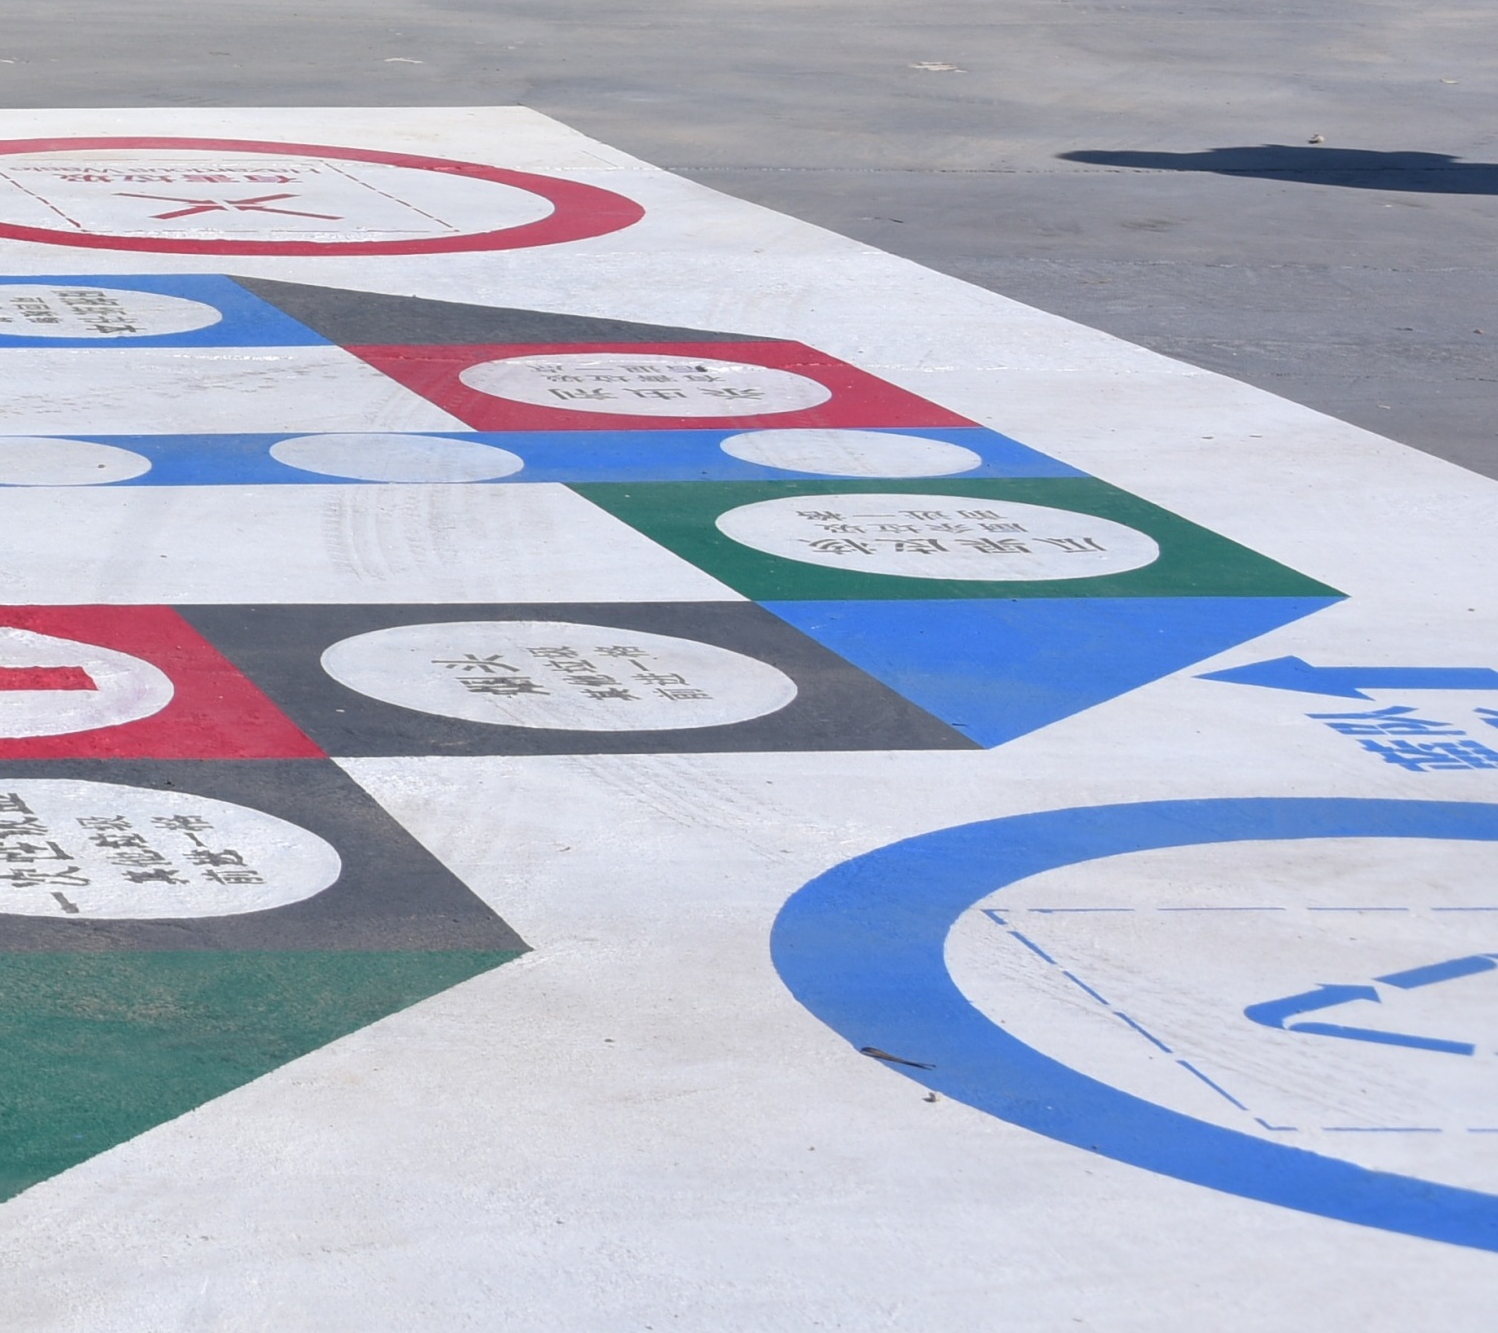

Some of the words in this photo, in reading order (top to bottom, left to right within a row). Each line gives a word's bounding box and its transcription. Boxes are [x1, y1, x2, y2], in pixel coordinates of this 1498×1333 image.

[51, 173, 304, 184] 有害垃圾
[548, 388, 765, 401] 杀虫剂
[795, 510, 1008, 521] 前进一格
[813, 523, 1026, 533] 厨余垃圾
[796, 538, 1107, 556] 瓜果皮核
[430, 651, 550, 696] 烟头
[526, 642, 638, 704] 其他垃圾
[594, 642, 716, 703] 前进一格
[1305, 705, 1498, 772] 蓝队
[93, 813, 180, 886] 其他垃圾
[153, 813, 267, 887] 前进一格
